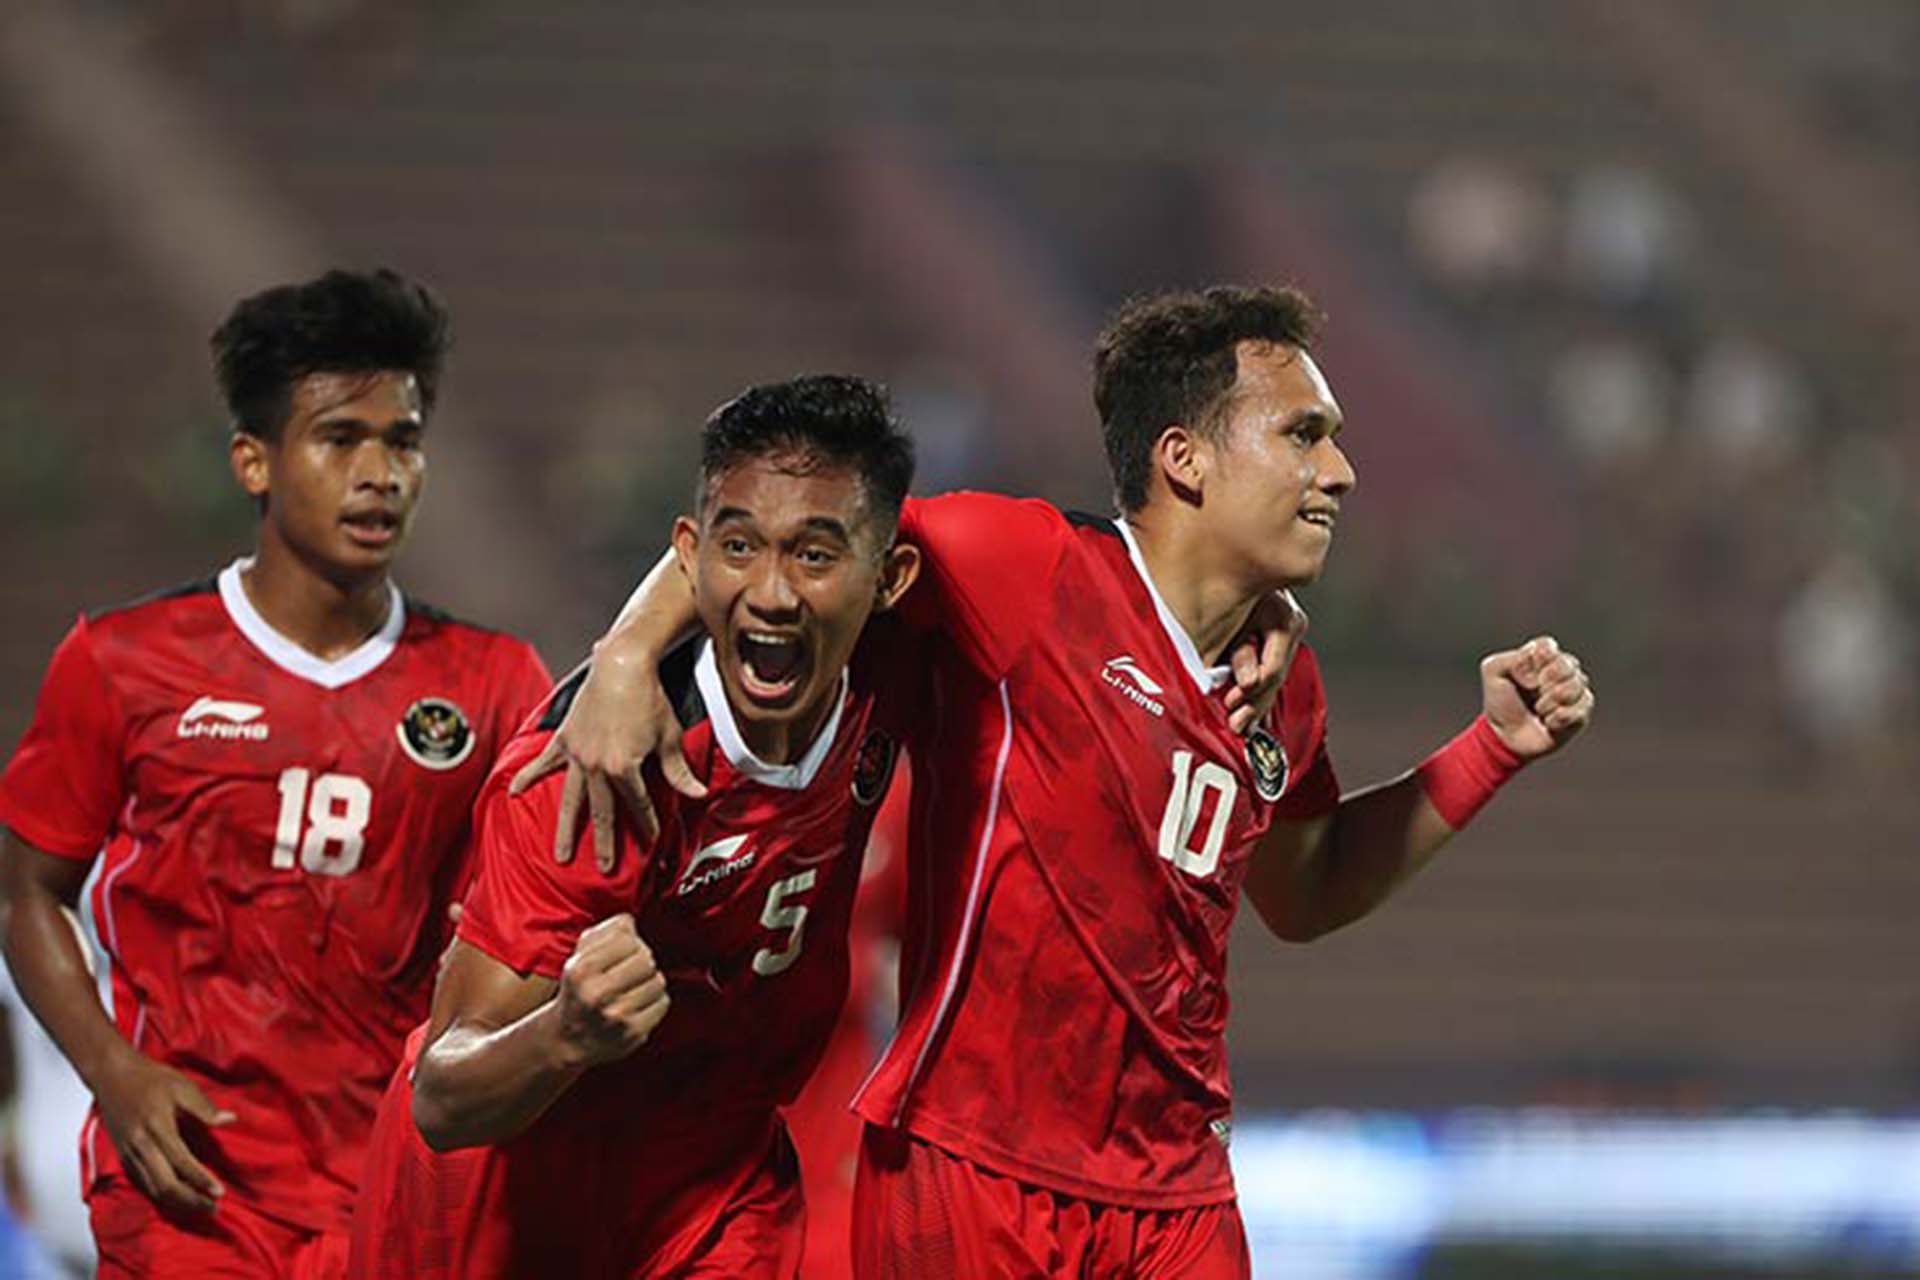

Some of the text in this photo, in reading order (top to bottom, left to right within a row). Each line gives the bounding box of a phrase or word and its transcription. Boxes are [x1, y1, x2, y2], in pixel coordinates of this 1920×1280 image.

[177, 719, 269, 741] LI-NING
[1101, 667, 1165, 717] LI-NING
[271, 767, 372, 877] 18
[1157, 750, 1238, 878] 10
[752, 868, 817, 976] 5
